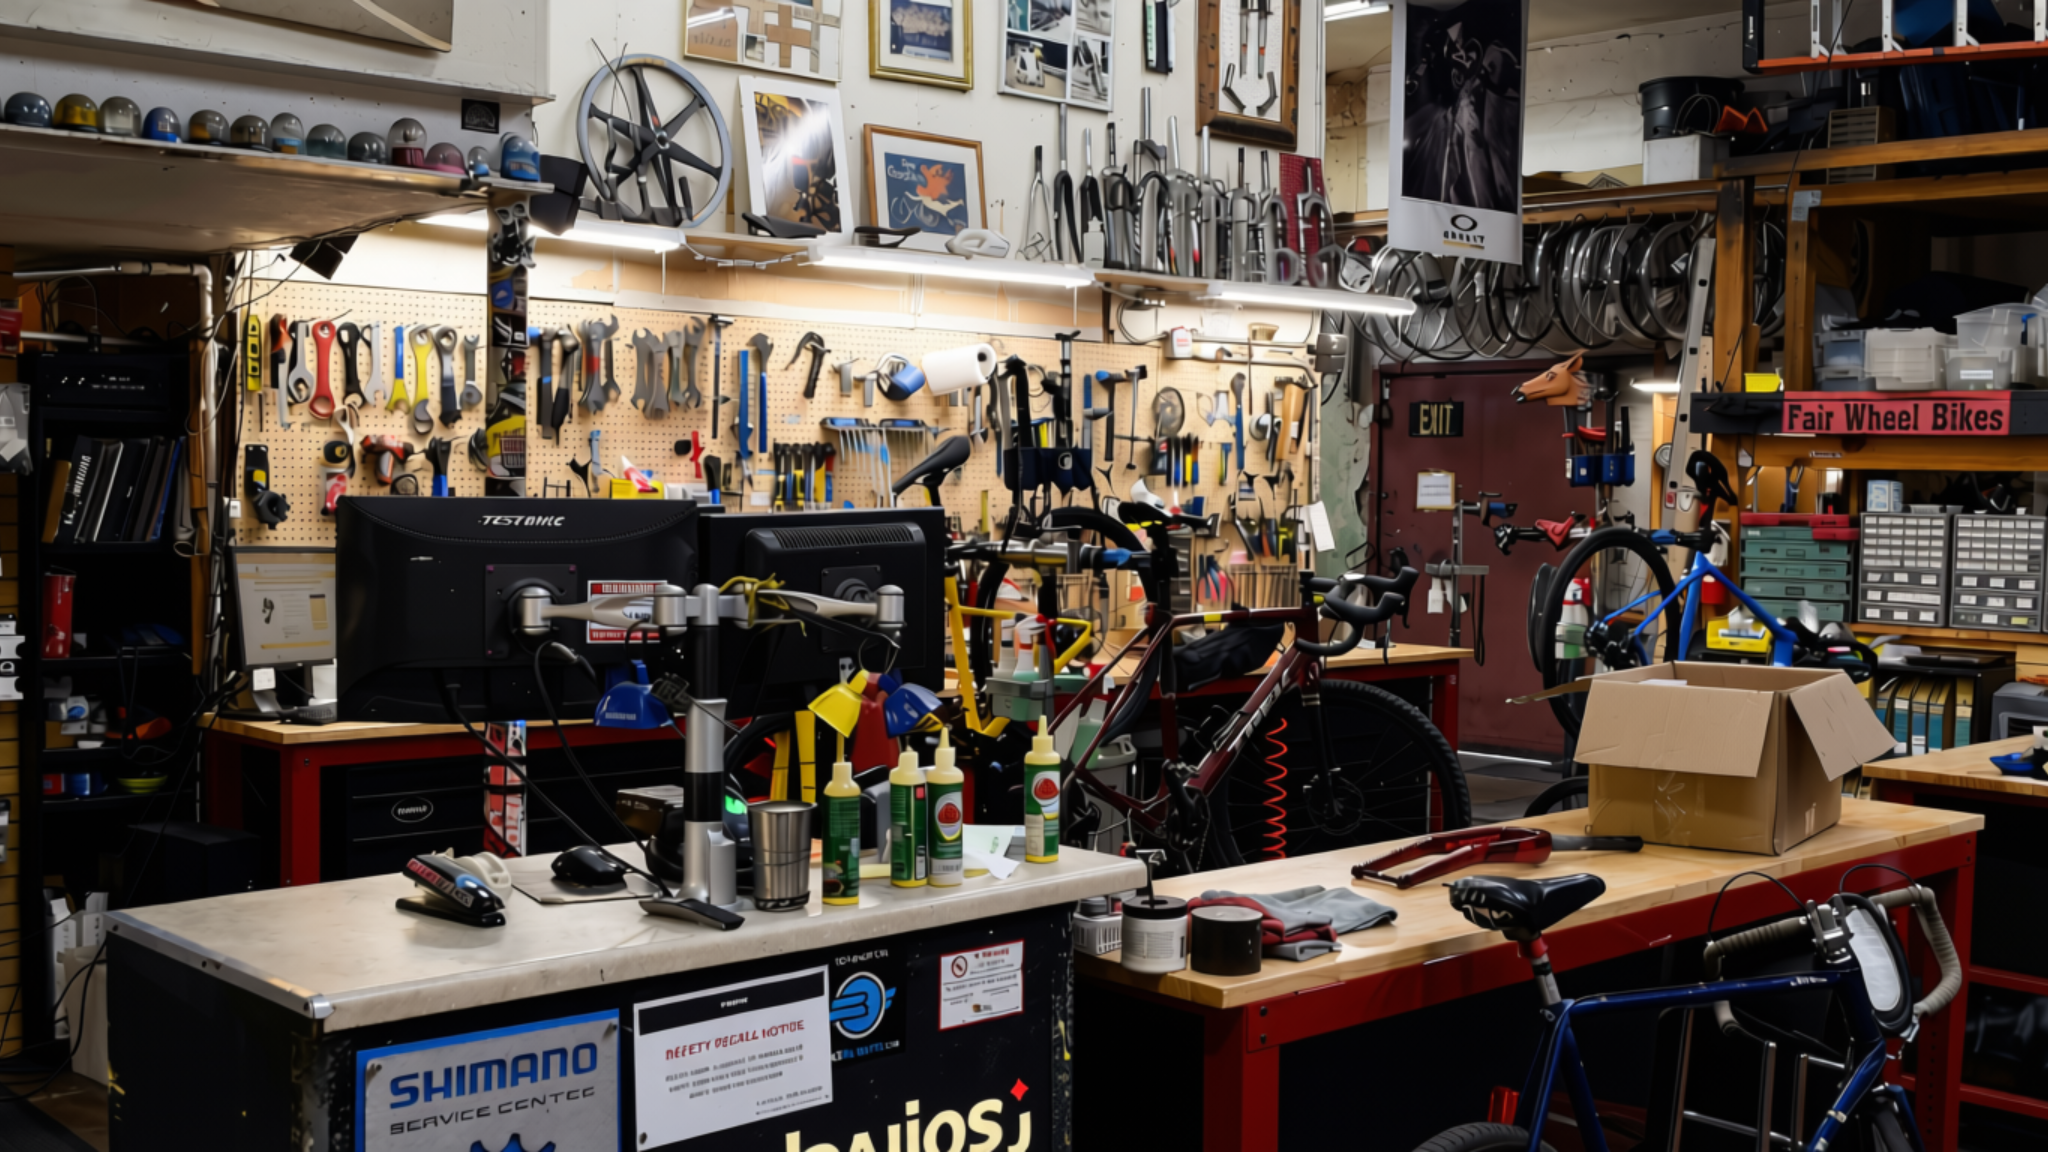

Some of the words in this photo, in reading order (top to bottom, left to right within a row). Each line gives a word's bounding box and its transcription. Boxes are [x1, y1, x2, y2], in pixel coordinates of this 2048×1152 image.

[1419, 403, 1454, 435] EXIT
[1788, 403, 1834, 432] Fair
[1844, 403, 1919, 432] Wheel
[1931, 402, 2004, 432] Bikes
[390, 1042, 598, 1110] SHIMANO
